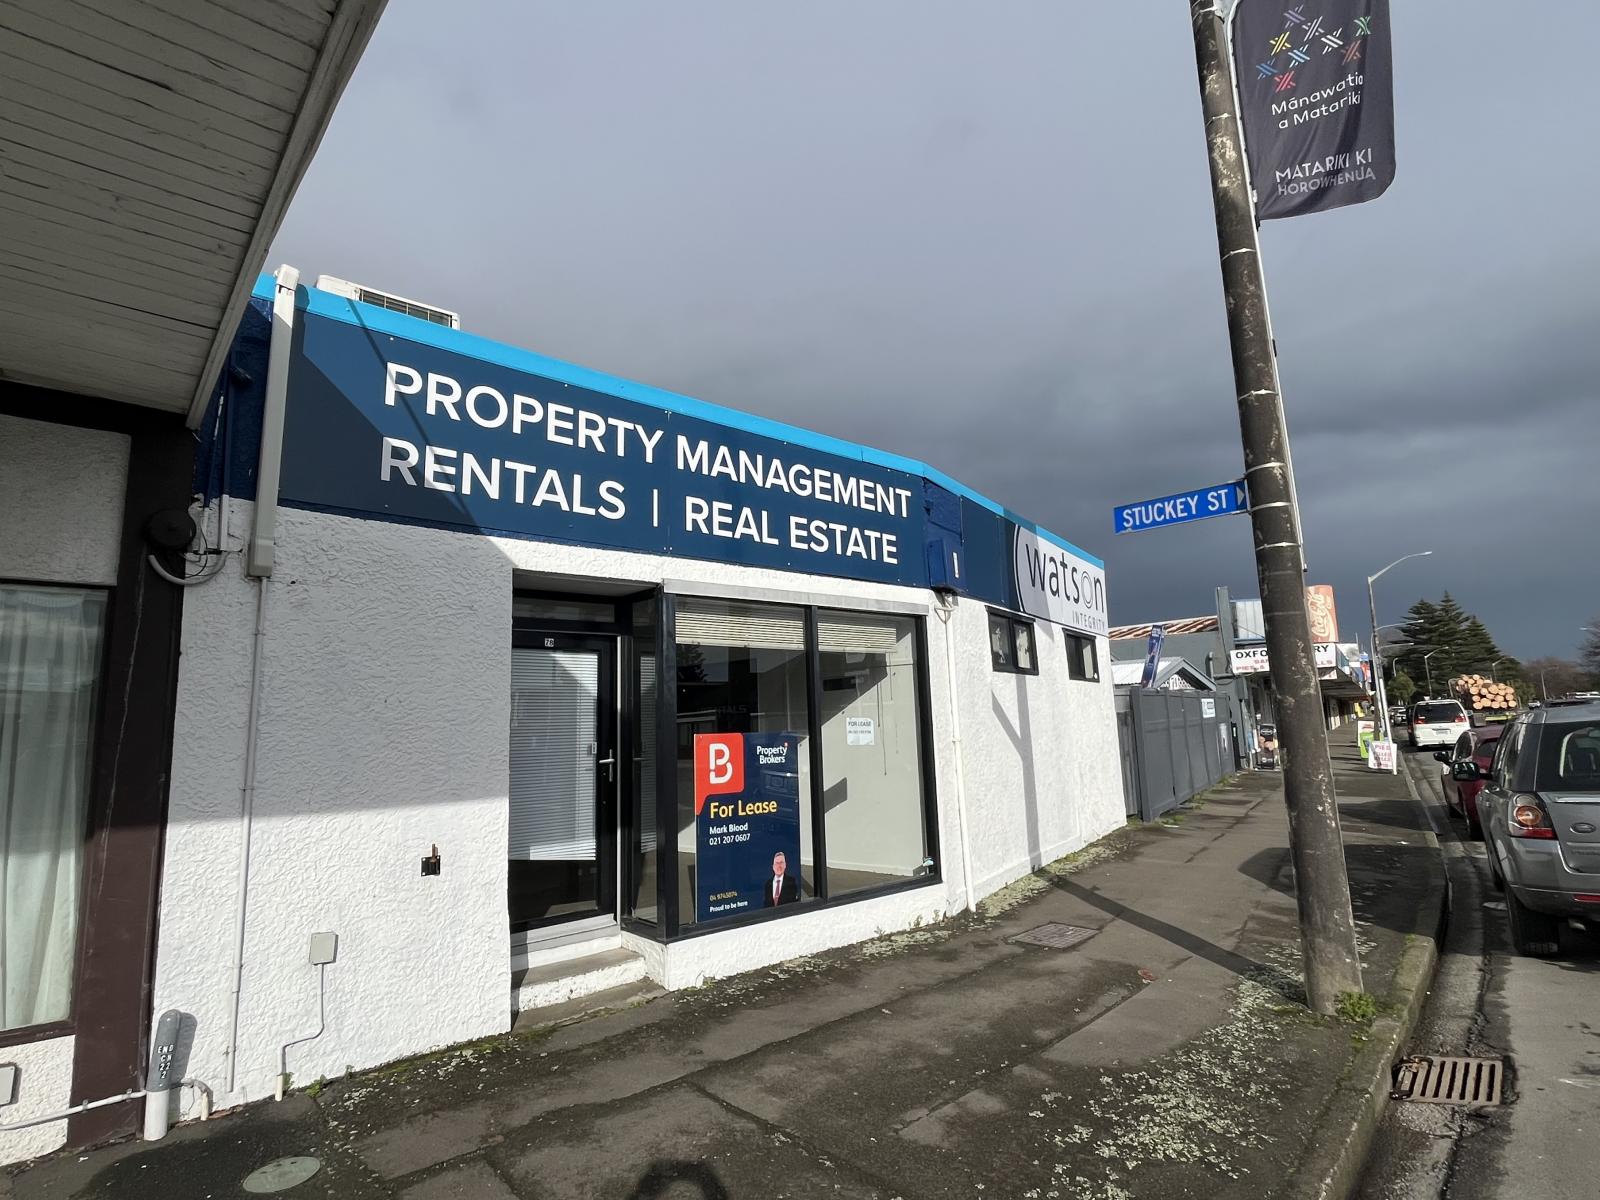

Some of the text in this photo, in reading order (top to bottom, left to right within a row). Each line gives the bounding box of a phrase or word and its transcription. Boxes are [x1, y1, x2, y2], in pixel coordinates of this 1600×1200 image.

[1278, 91, 1361, 129] a Matariki
[1275, 148, 1372, 183] MATARIKI KI
[1277, 166, 1377, 196] HOROWHENUA
[384, 361, 912, 518] PROPERTY MANAGEMENT
[380, 436, 626, 520] RENTALS
[685, 495, 779, 546] REAL
[789, 515, 898, 565] ESTATE
[1121, 489, 1229, 528] STUCKEY ST
[1235, 650, 1268, 659] OXFO
[756, 745, 787, 757] Property
[759, 754, 785, 765] Brokers
[710, 799, 777, 819] For Lease
[709, 822, 748, 835] Mark Blood
[709, 837, 721, 846] 021
[723, 834, 735, 844] 207
[710, 904, 724, 913] Proud
[158, 1044, 174, 1053] END
